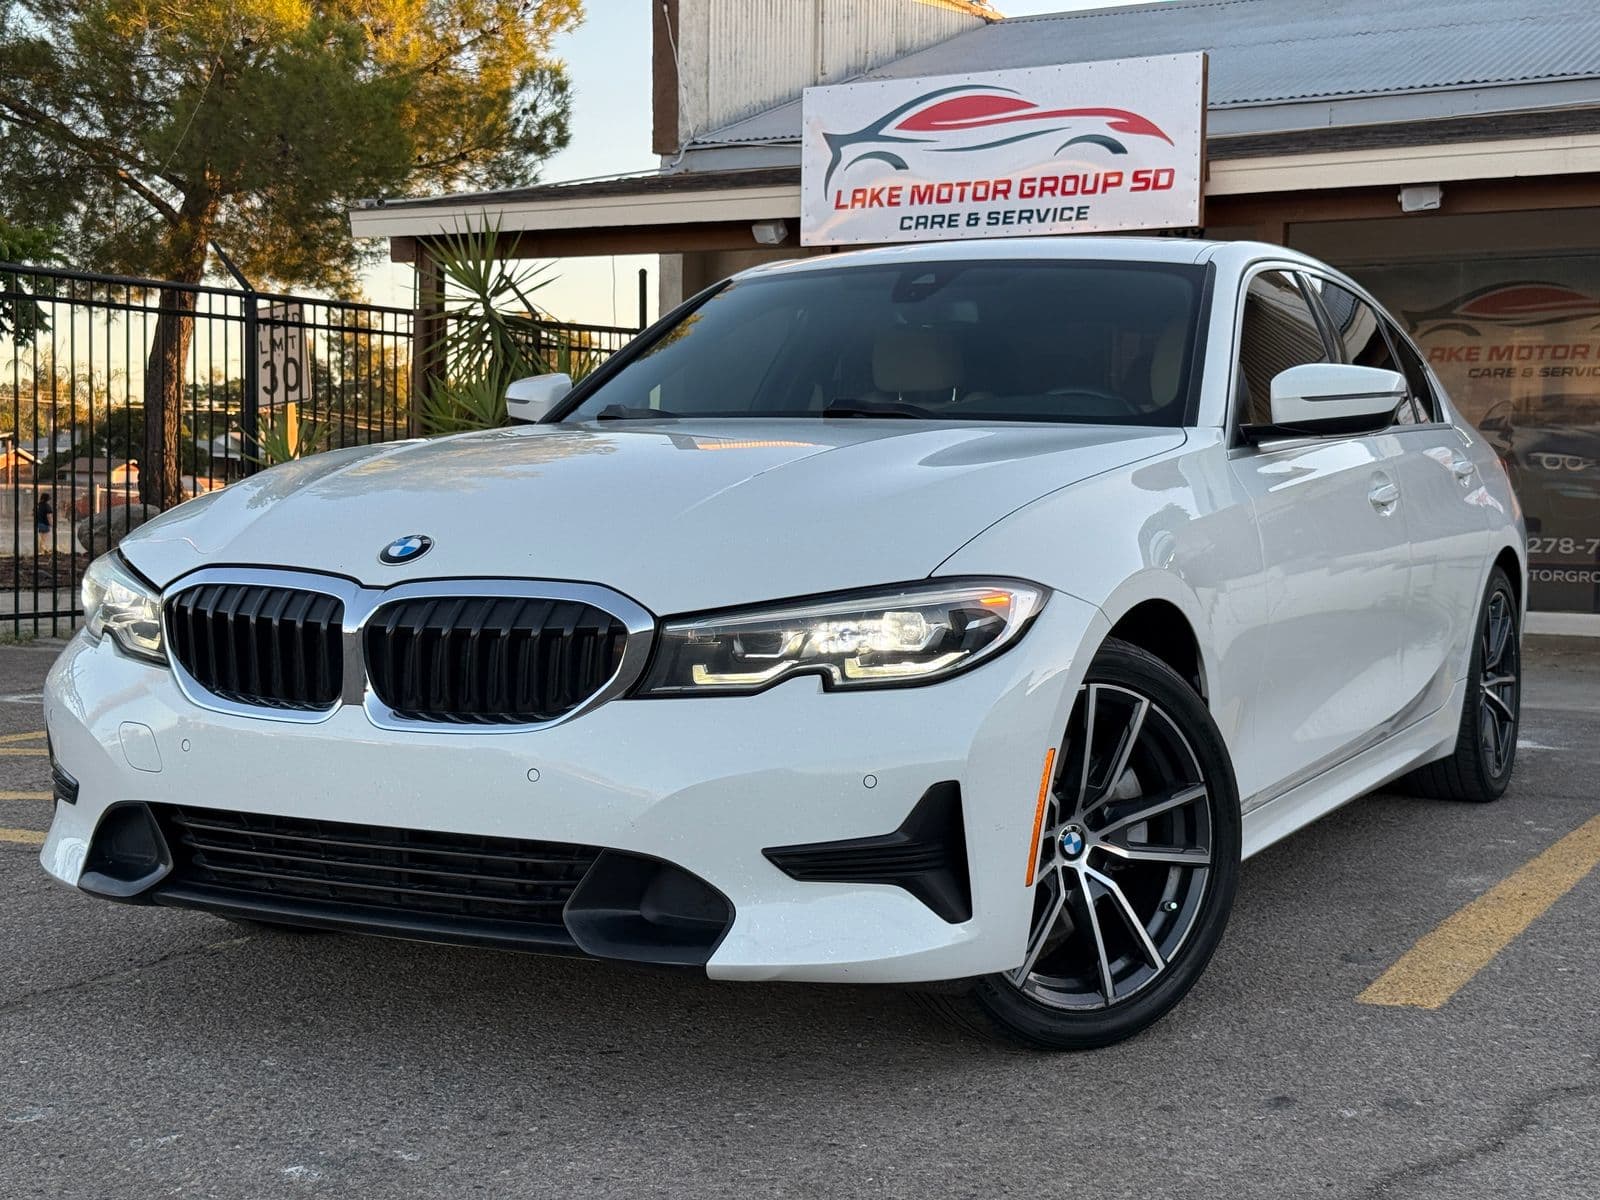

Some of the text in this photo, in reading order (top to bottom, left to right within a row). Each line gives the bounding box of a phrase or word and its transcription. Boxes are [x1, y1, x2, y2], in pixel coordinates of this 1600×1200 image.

[834, 168, 1175, 210] LAKE MOTOR GROUP SD
[899, 205, 1090, 231] CARE & SERVICE
[260, 335, 297, 354] LMT
[1429, 346, 1481, 362] AKE
[1488, 344, 1590, 362] MOTOR
[262, 357, 301, 396] 30
[1468, 367, 1516, 378] CARE
[1521, 367, 1533, 377] &
[1527, 569, 1600, 583] TORGRO
